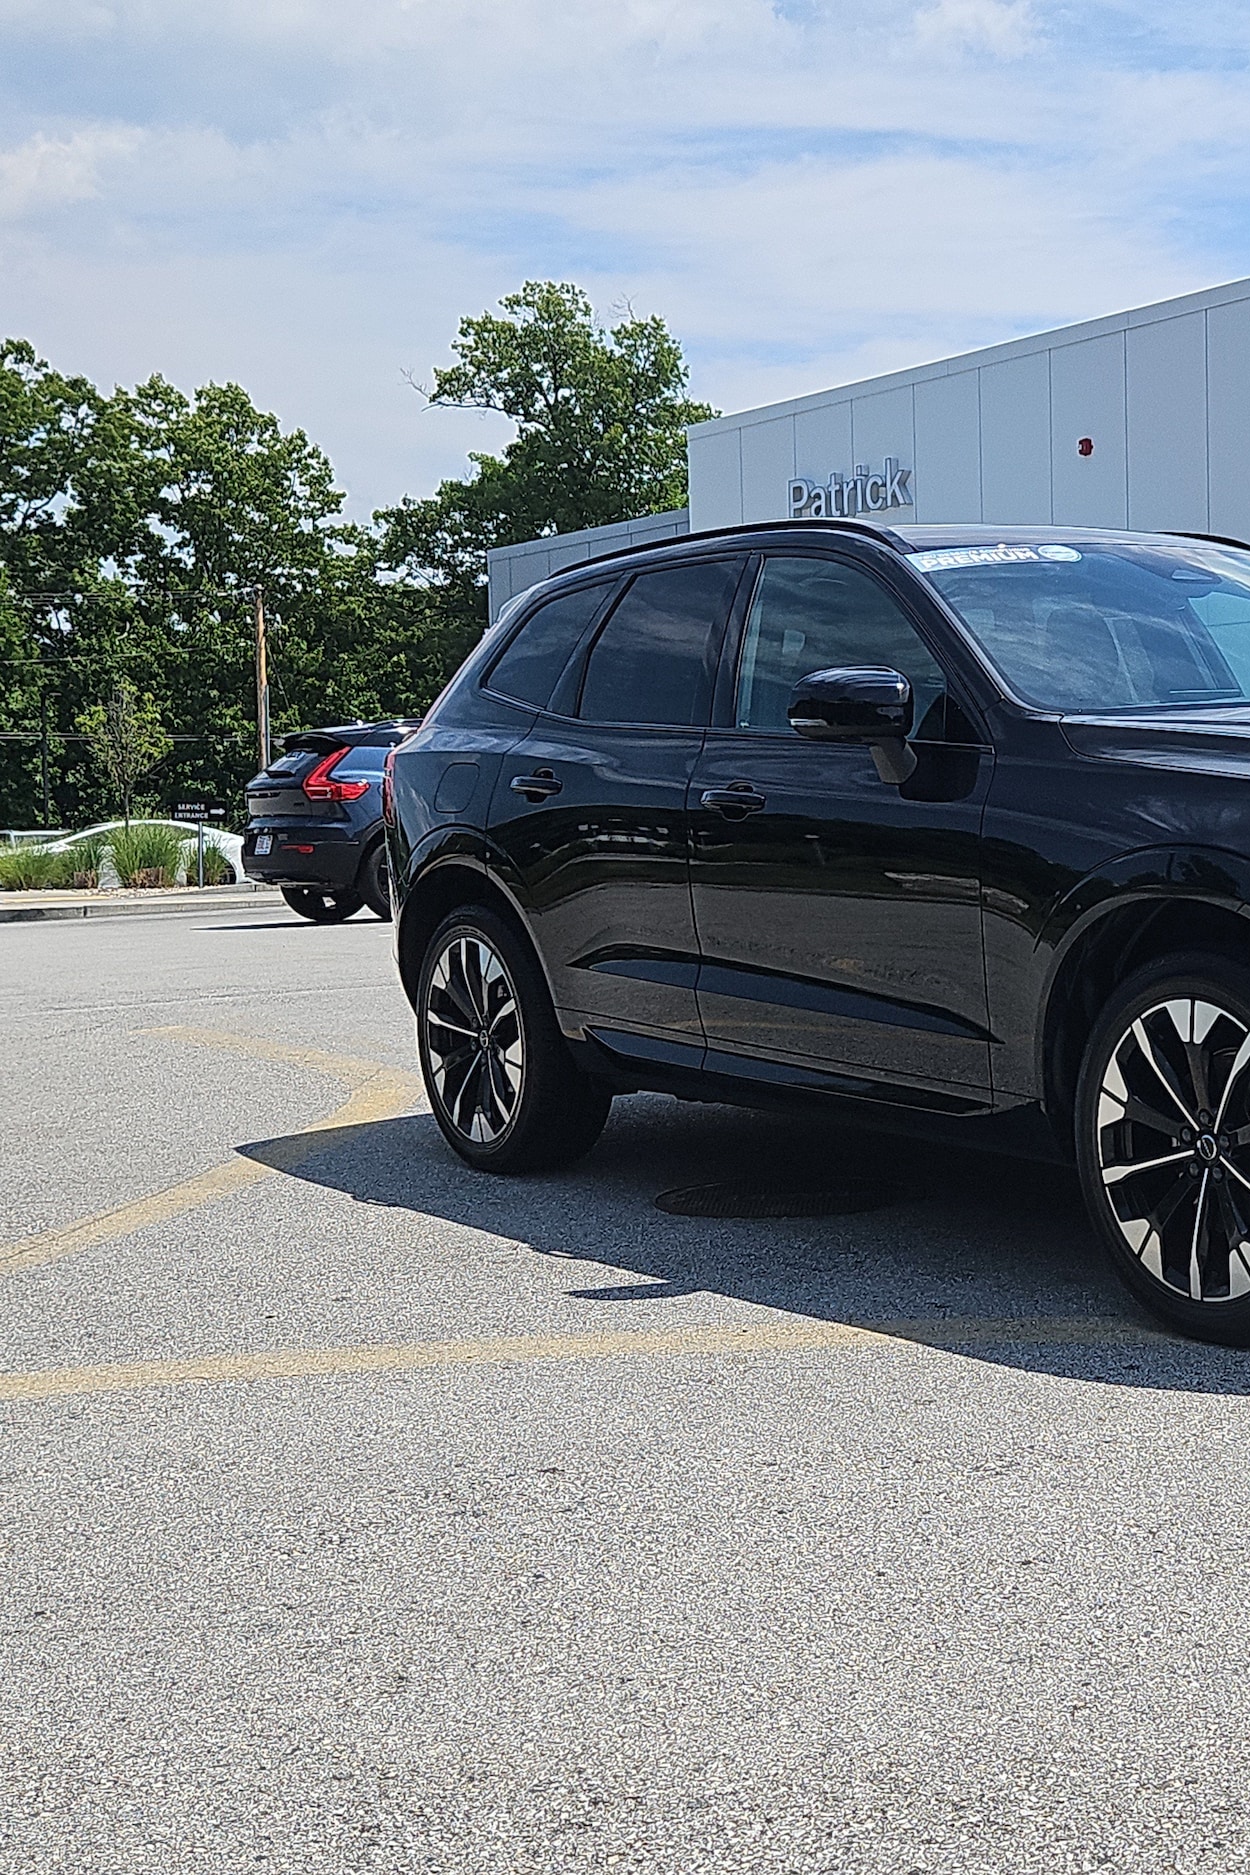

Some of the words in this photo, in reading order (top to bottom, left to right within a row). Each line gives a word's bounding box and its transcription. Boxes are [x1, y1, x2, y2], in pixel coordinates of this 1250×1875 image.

[788, 457, 912, 517] Patrick
[920, 550, 1039, 569] PREMIUM
[178, 803, 205, 811] SERVICE
